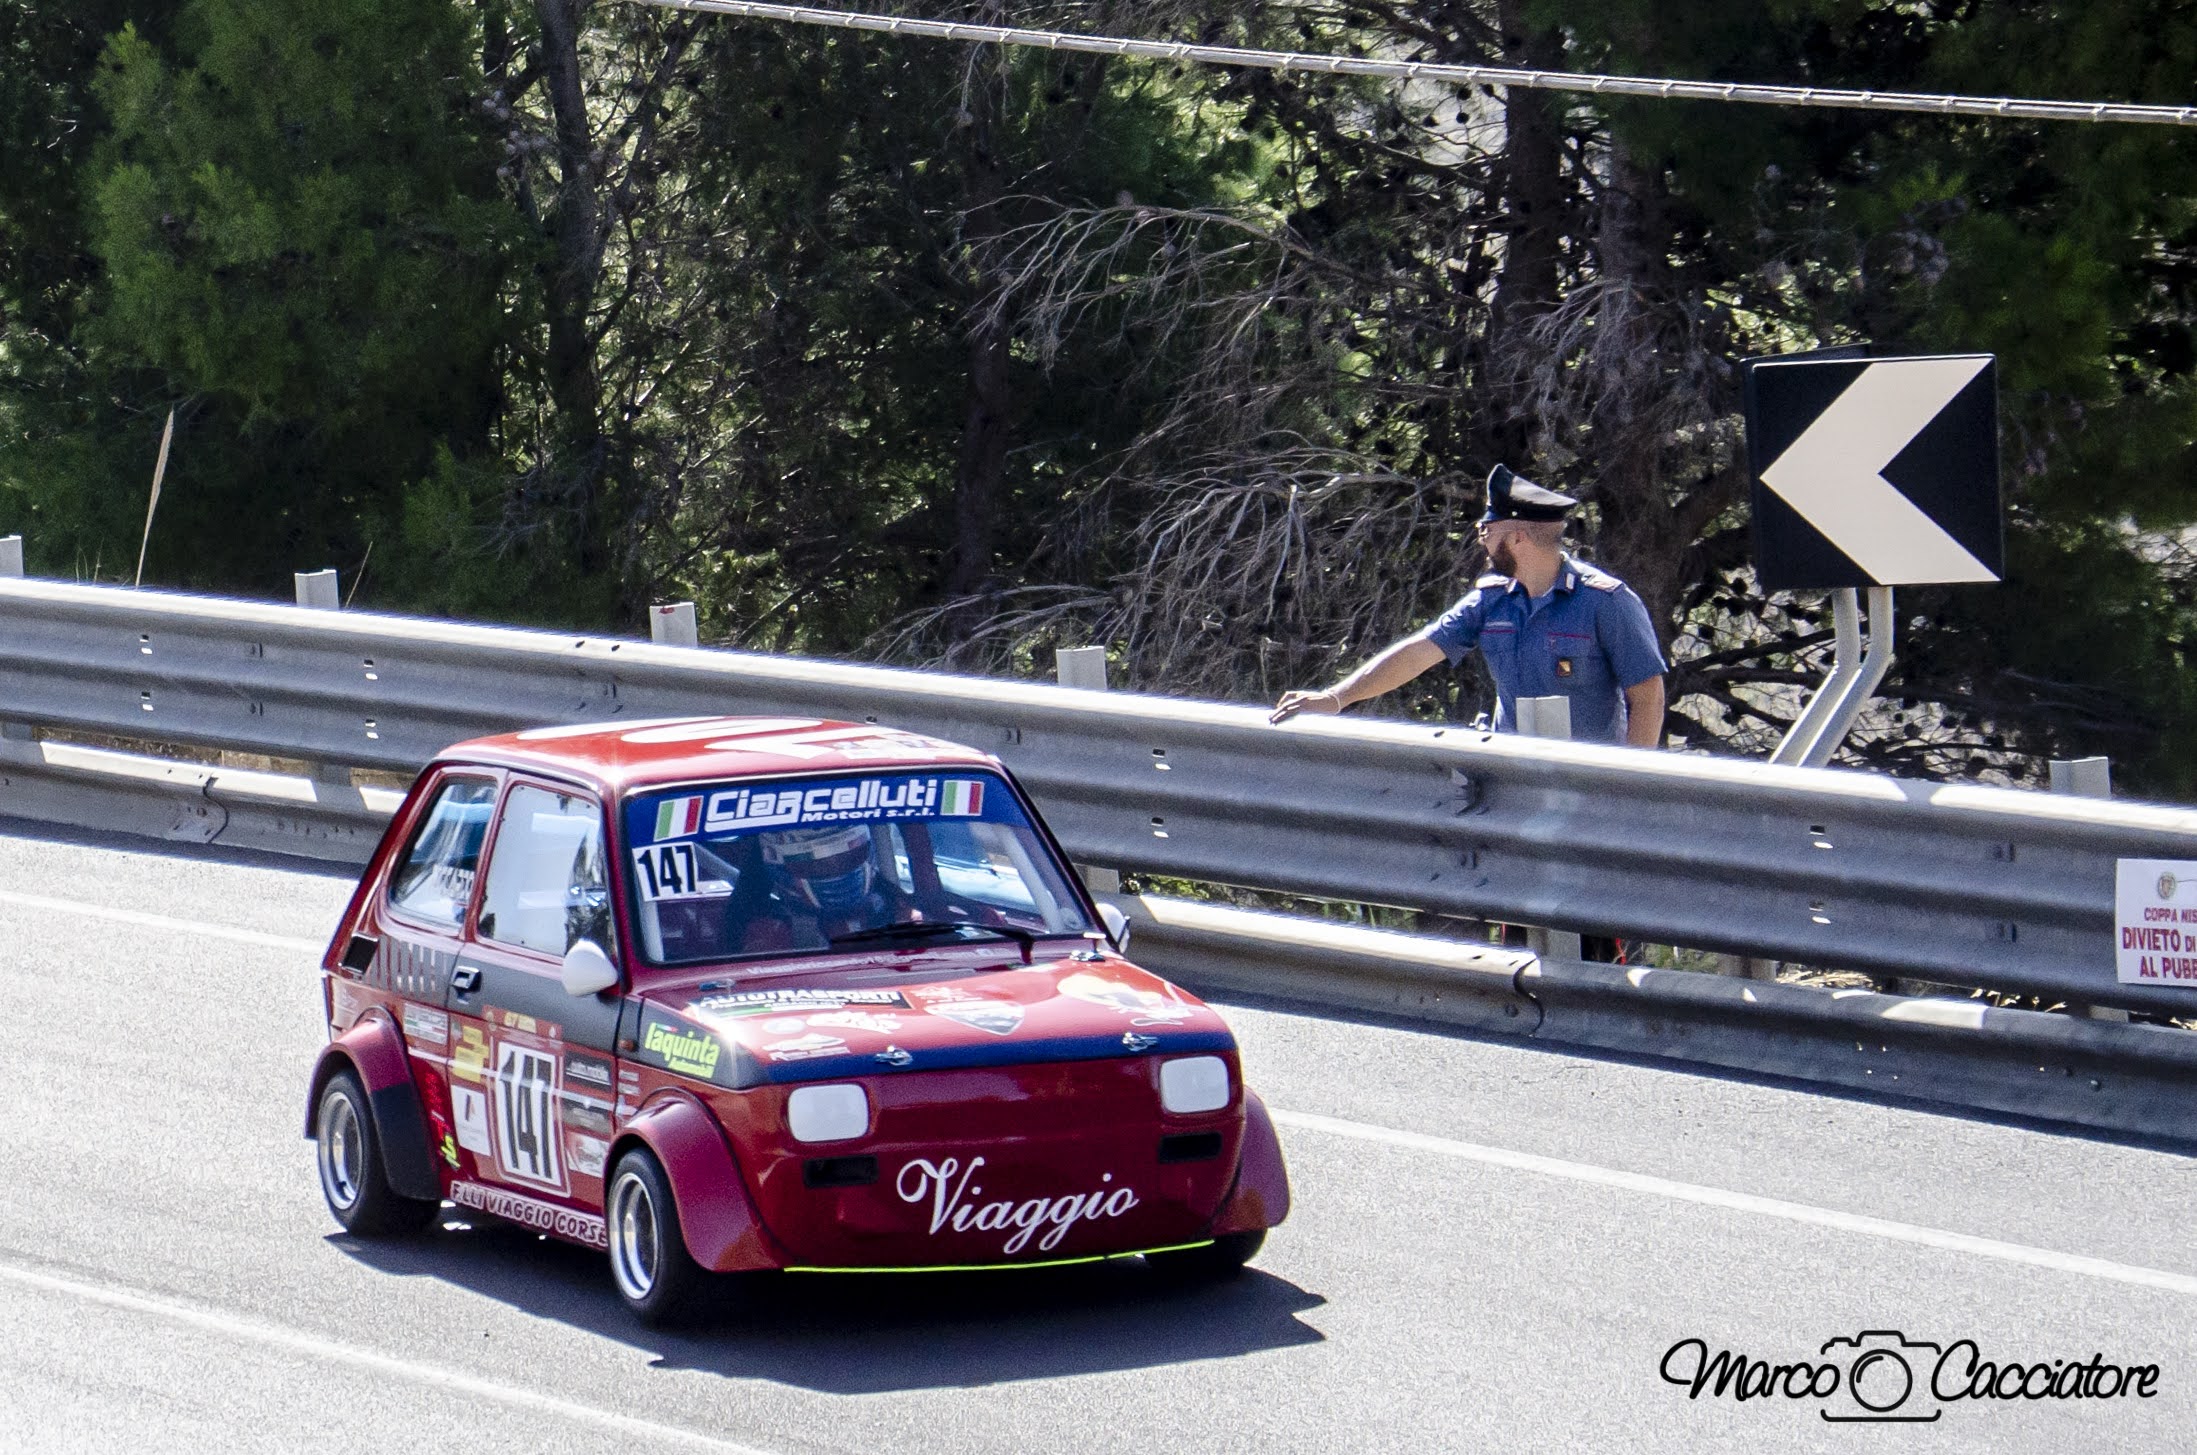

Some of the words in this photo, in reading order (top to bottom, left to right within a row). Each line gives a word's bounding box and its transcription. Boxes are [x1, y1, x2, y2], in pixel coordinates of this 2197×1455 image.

[801, 807, 881, 823] Motori
[885, 806, 935, 819] s.r.l.
[637, 845, 697, 898] 147
[2144, 907, 2177, 921] COPPA
[2122, 927, 2180, 952] DIVIETO
[2184, 935, 2196, 952] DI
[2140, 955, 2158, 978] AL
[501, 1050, 553, 1180] 147
[487, 1192, 553, 1229] VIAGGIO
[896, 1156, 1140, 1254] Viaggio
